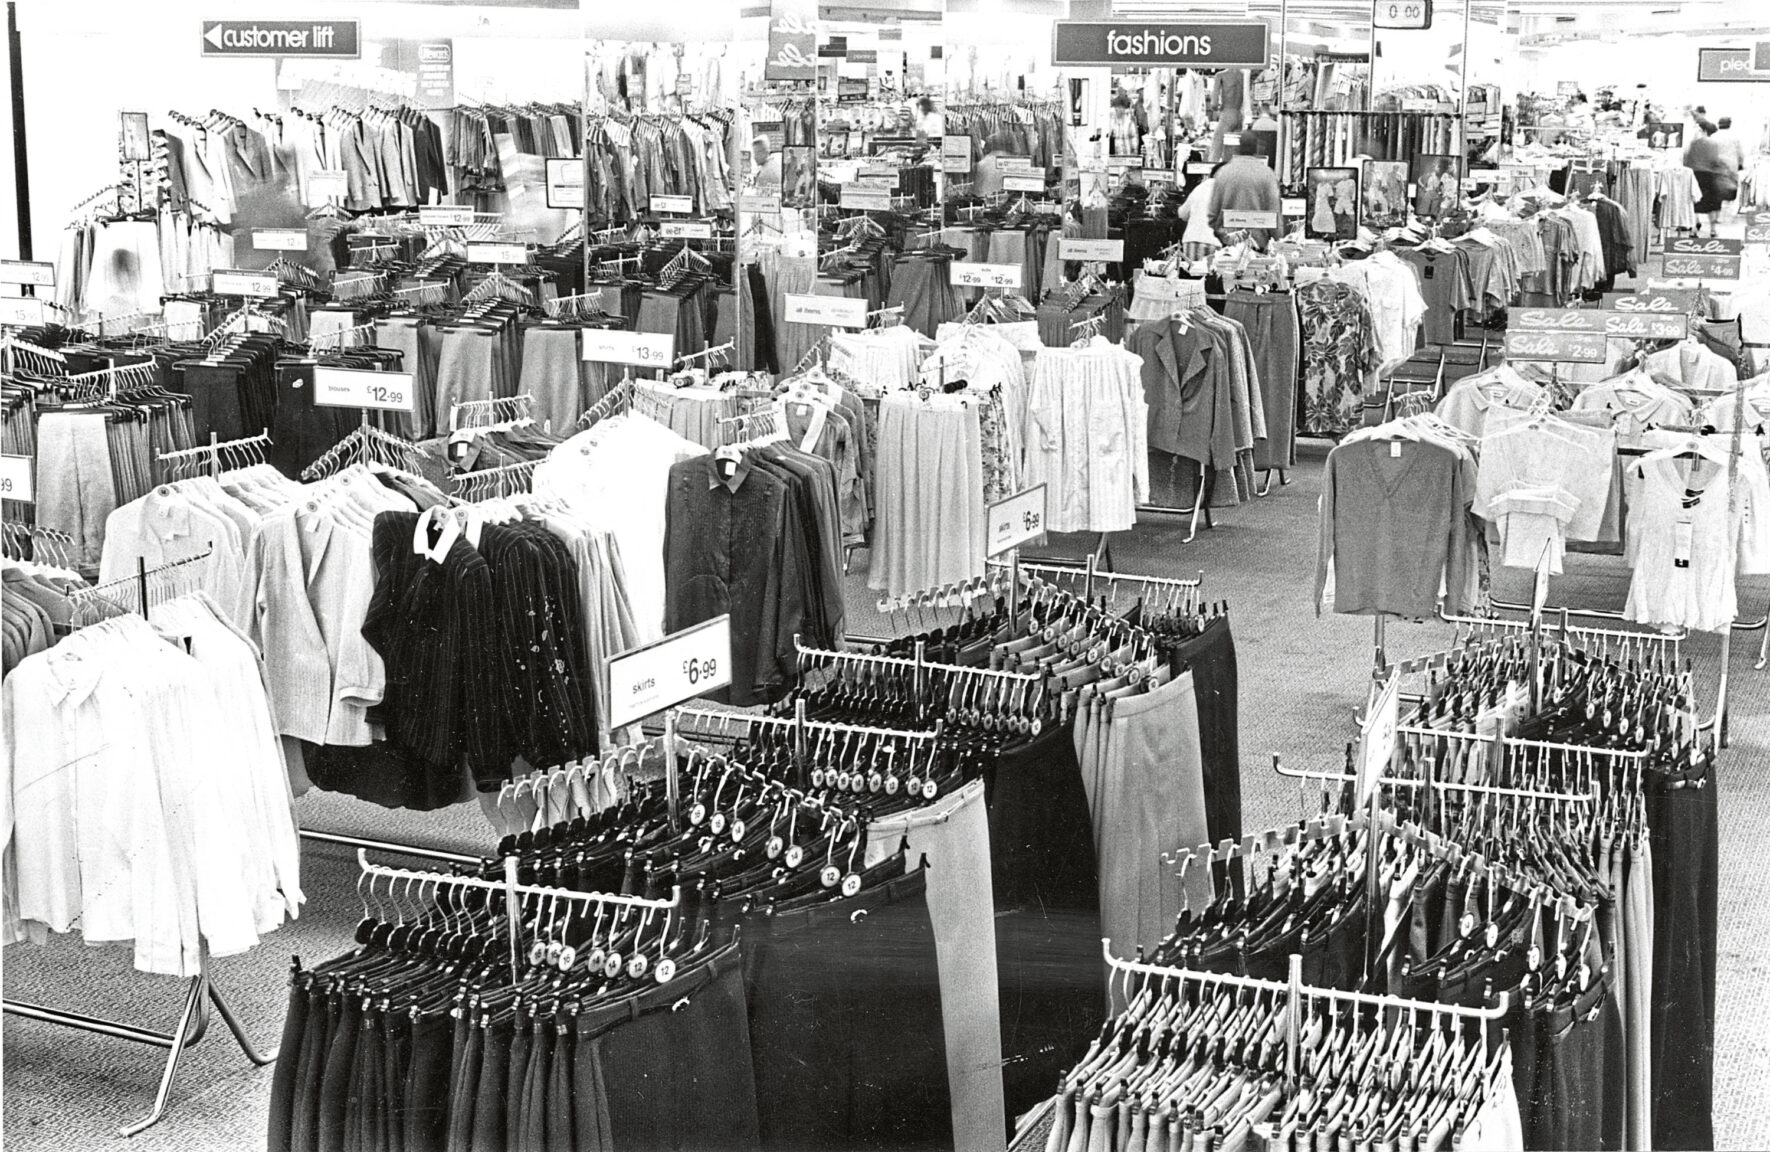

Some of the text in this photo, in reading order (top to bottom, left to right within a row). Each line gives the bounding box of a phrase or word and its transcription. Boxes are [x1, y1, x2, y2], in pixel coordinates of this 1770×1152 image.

[224, 26, 334, 49] customer lift
[1107, 29, 1212, 54] fashions
[1673, 239, 1730, 253] Sale
[1665, 258, 1704, 274] Sale
[1614, 296, 1679, 311] Sale
[1520, 310, 1593, 328] Sale
[1606, 316, 1649, 333] Sale
[632, 345, 664, 361] £13.99
[1509, 334, 1598, 358] Sale £2.99
[366, 386, 403, 404] £12.99
[1022, 511, 1040, 531] £6.99
[632, 657, 718, 695] skirts £6.99
[827, 871, 836, 882] 12
[848, 880, 857, 890] 12
[608, 960, 617, 971] 14
[634, 963, 643, 973] 12
[661, 966, 670, 976] 12
